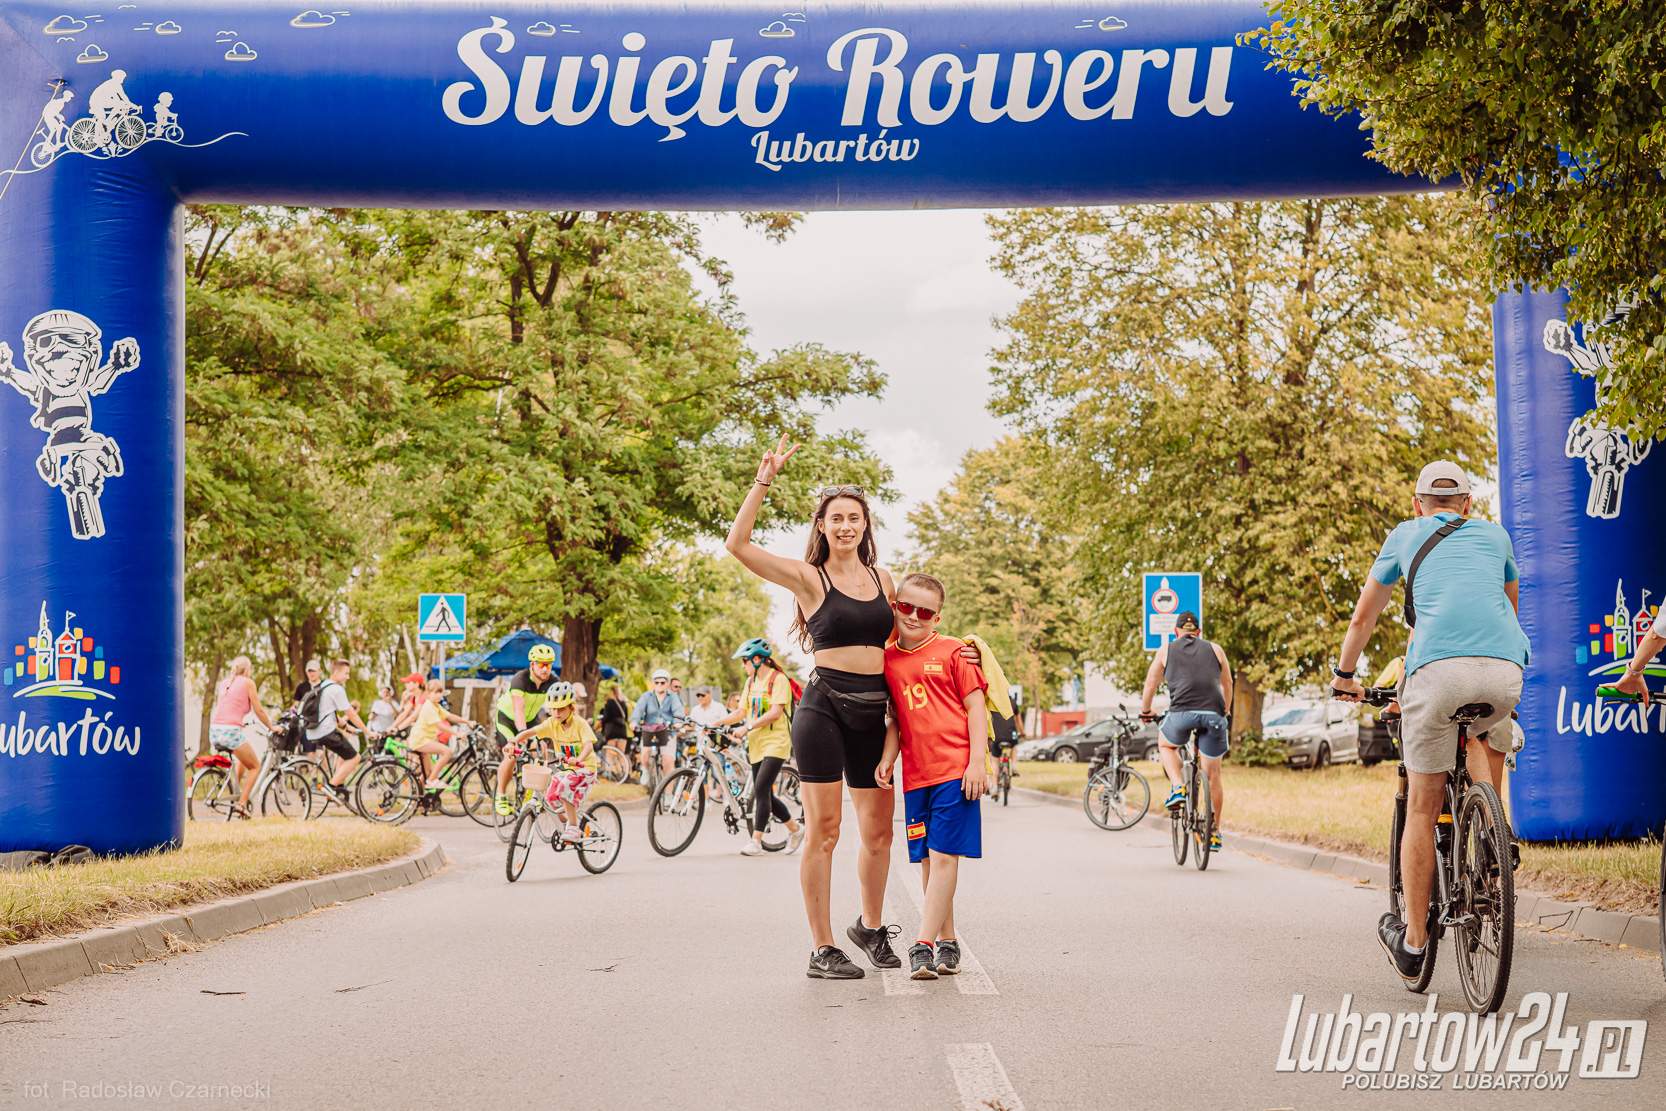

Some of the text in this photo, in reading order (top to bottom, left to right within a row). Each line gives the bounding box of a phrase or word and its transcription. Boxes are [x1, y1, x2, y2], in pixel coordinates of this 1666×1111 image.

[441, 16, 1234, 142] Święto Roweru
[750, 128, 920, 172] Lubartów
[903, 683, 928, 710] 19
[1556, 685, 1666, 737] Lubar
[0, 707, 141, 758] ubartów
